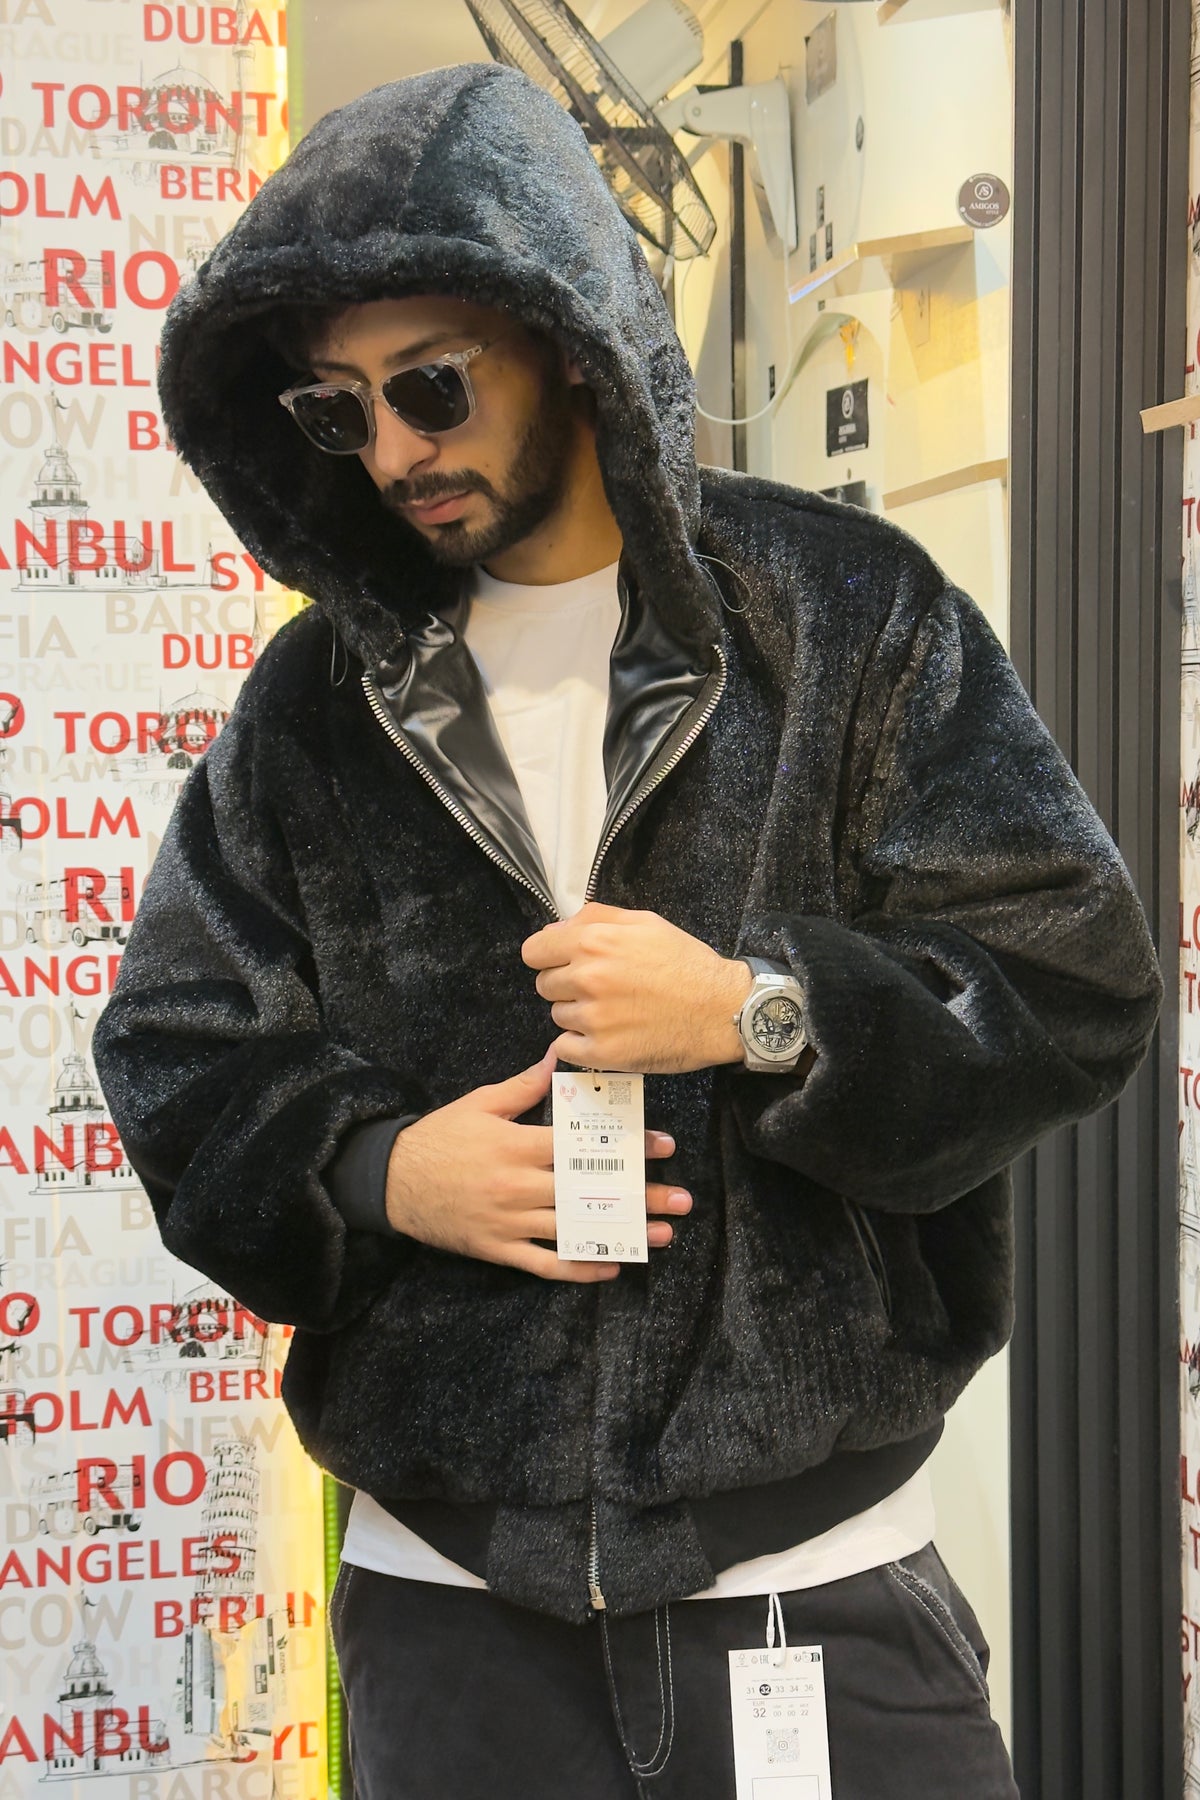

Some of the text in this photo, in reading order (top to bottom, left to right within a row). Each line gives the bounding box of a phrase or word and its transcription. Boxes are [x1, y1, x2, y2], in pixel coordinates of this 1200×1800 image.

[143, 3, 287, 47] DUBAI
[43, 248, 181, 311] RIO
[0, 341, 162, 387] NGEL
[211, 551, 290, 592] SY
[54, 711, 230, 755] TORO
[0, 796, 141, 840] OLM
[64, 866, 149, 924] RI
[4, 1214, 93, 1260] FIA
[69, 1302, 295, 1349] TORON
[158, 1412, 287, 1458] NEW
[76, 1451, 208, 1514] RIO
[0, 1534, 241, 1590] ANGELES
[752, 1707, 767, 1718] 32
